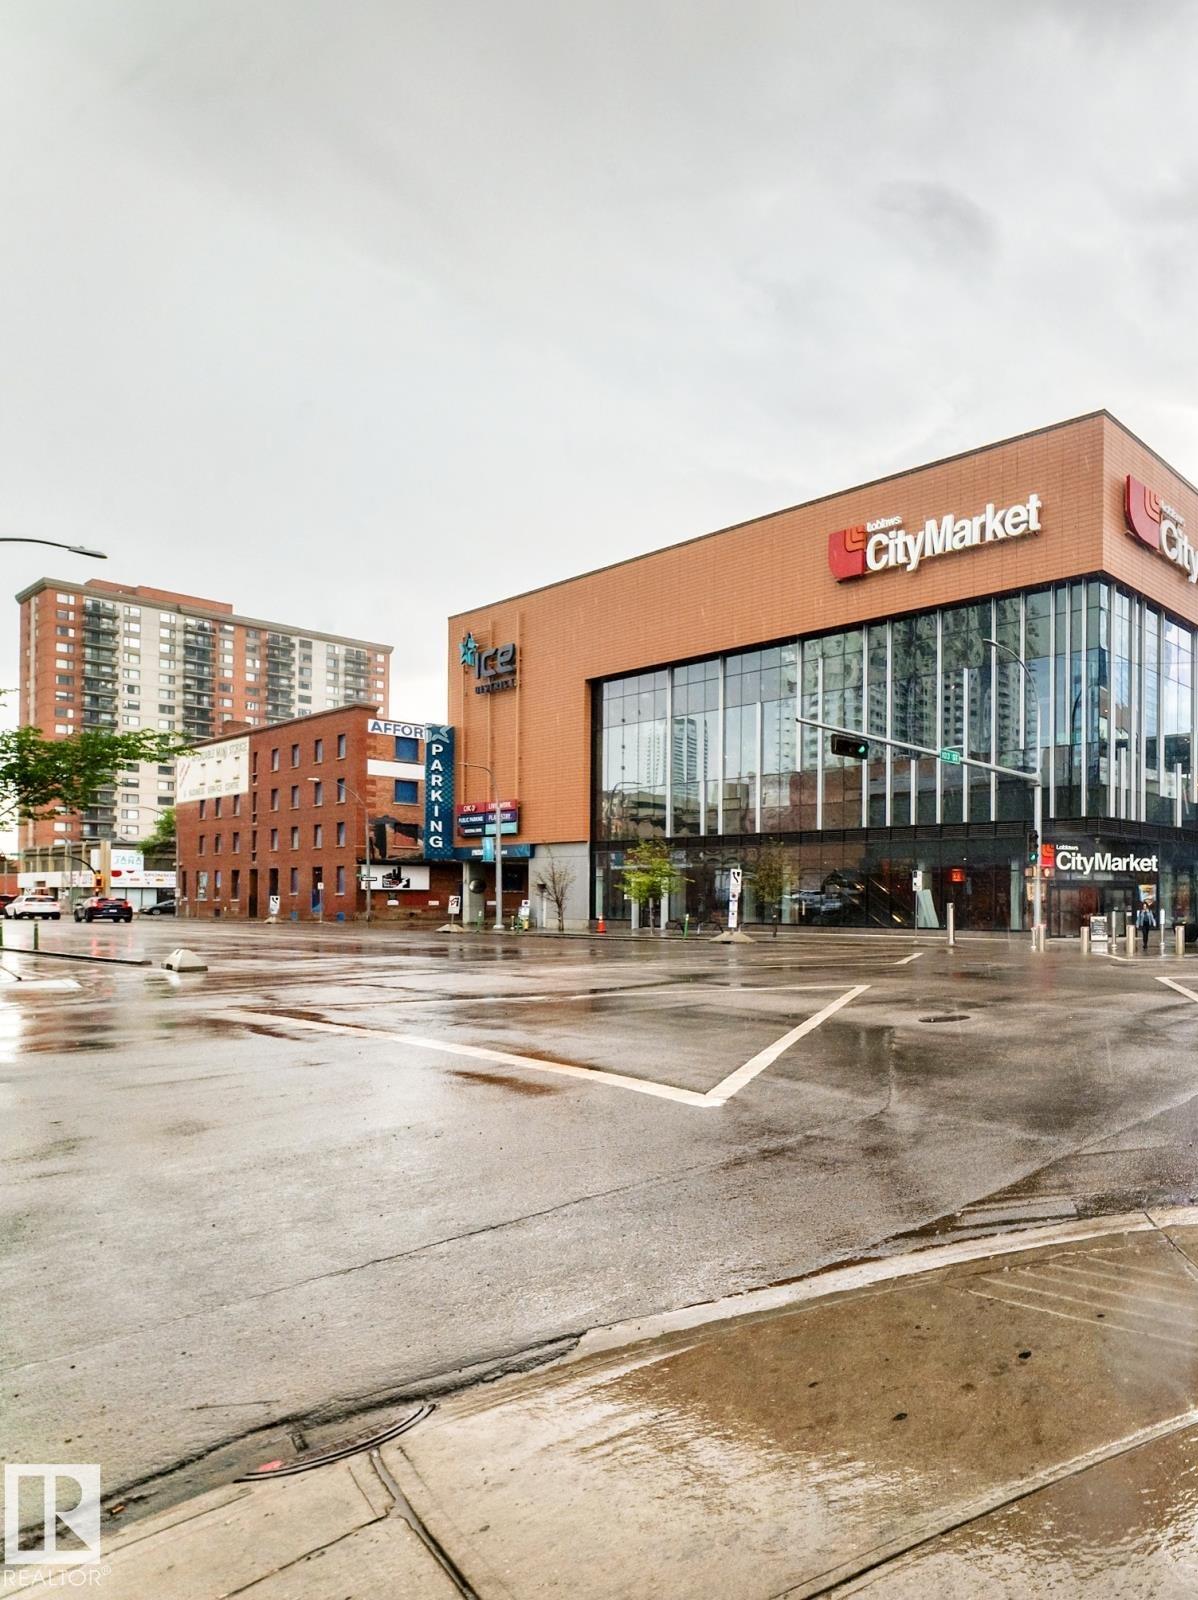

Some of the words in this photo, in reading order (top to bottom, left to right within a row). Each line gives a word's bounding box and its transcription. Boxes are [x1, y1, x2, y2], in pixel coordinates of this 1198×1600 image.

[866, 493, 1042, 572] CityMarket
[429, 743, 444, 848] PARKING
[1055, 851, 1158, 875] CityMarket
